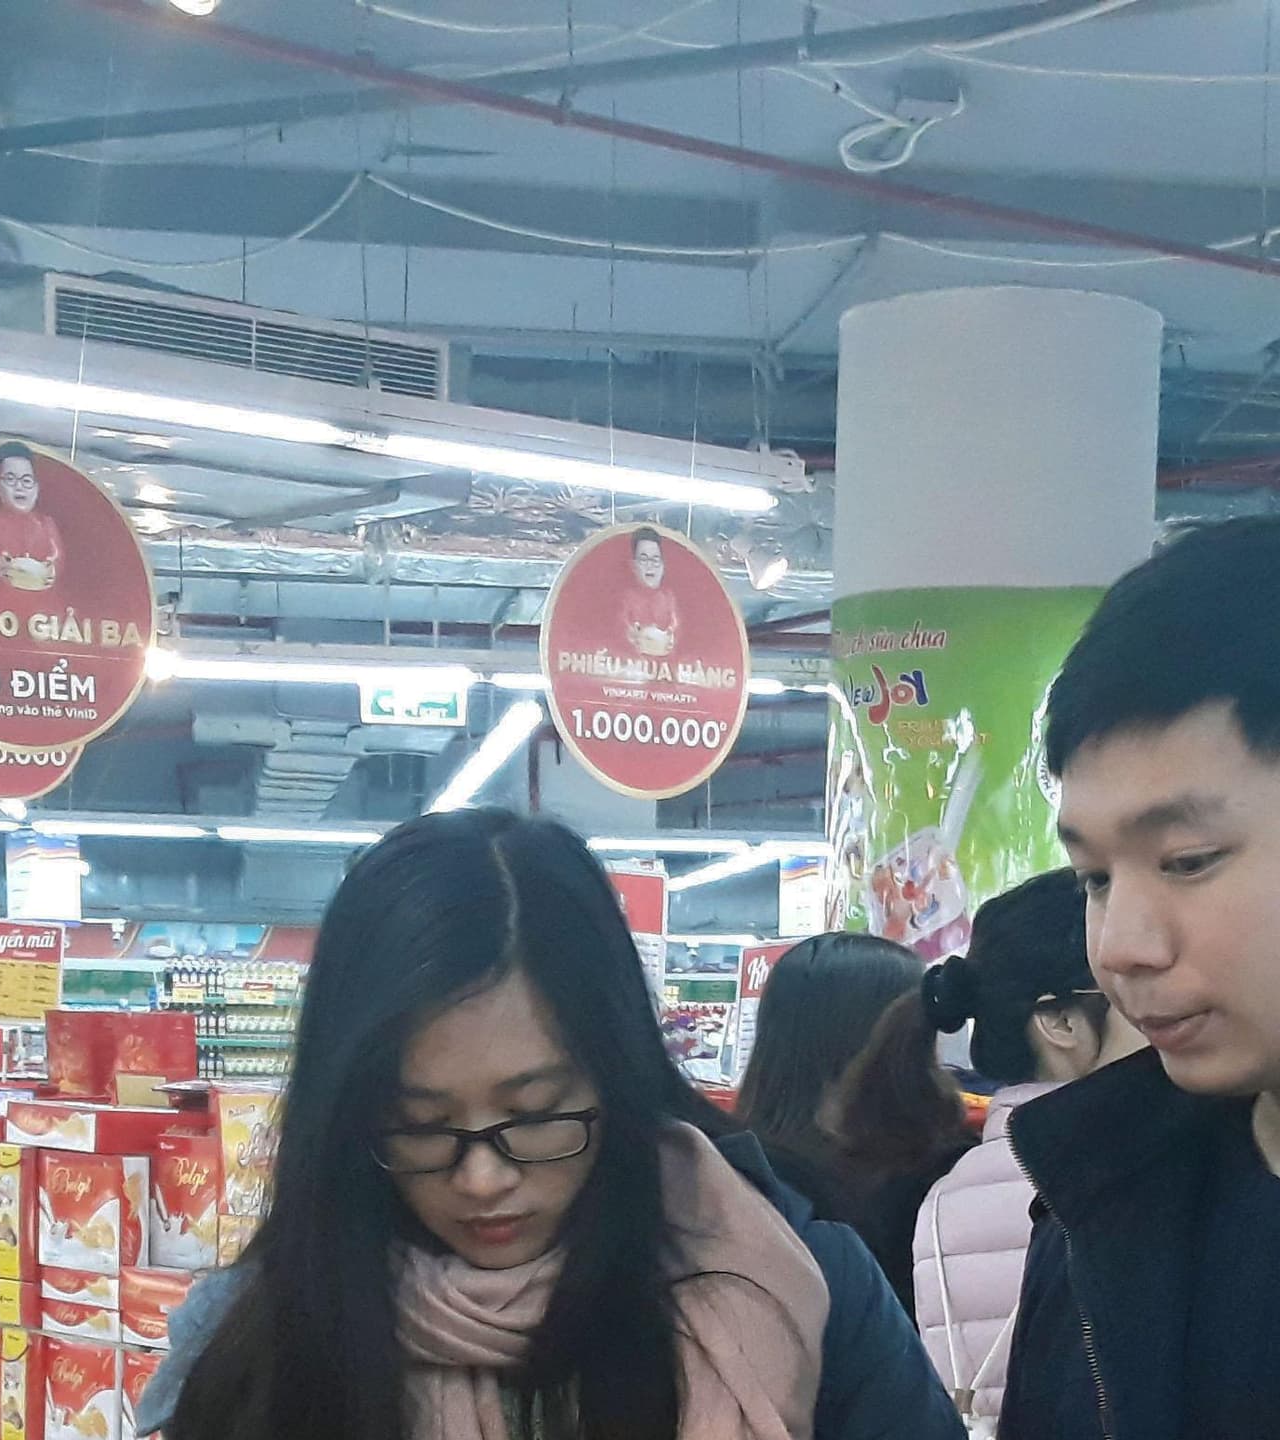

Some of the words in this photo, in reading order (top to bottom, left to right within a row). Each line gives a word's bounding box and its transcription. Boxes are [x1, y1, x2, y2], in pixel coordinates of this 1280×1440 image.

[27, 606, 92, 646] GIẢI
[100, 619, 143, 647] BA
[10, 658, 96, 703] ĐIỂM
[559, 648, 620, 677] PHIẾU
[622, 658, 672, 682] MUA
[678, 660, 737, 688] HÀNG
[26, 930, 56, 948] mãi
